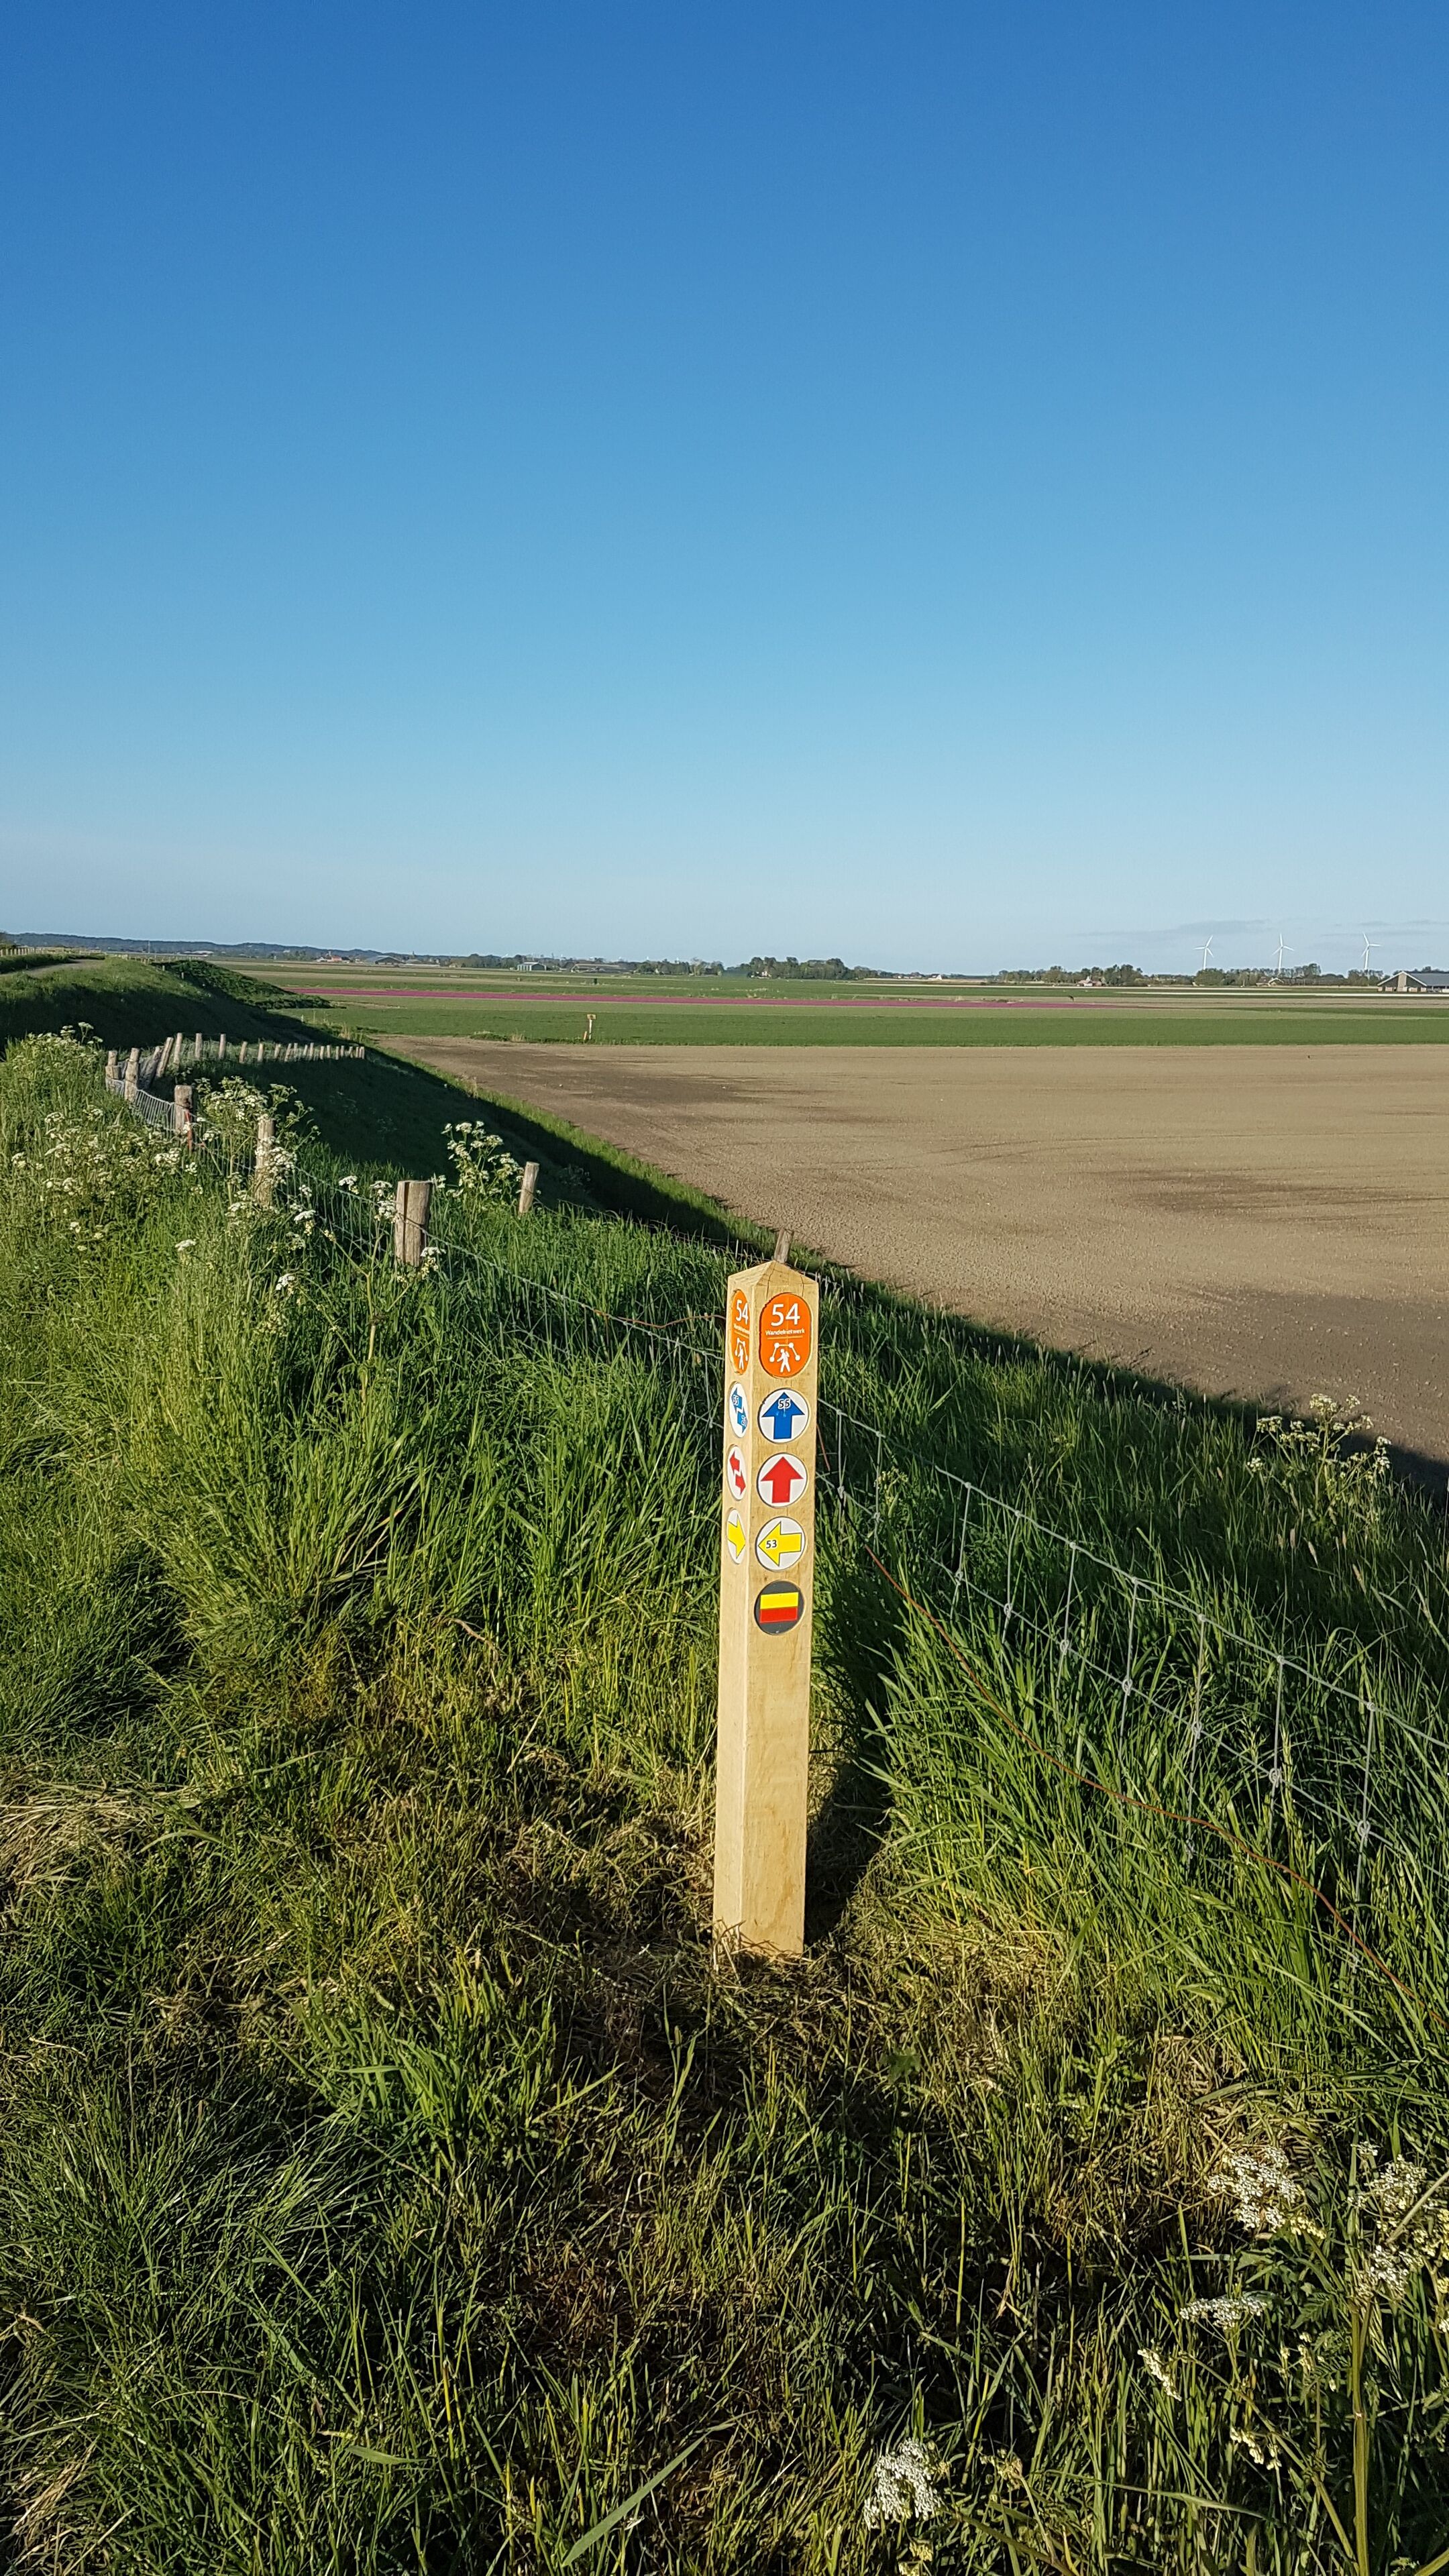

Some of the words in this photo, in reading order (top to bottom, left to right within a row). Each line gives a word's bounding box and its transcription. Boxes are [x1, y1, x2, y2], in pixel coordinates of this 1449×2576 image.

[736, 1299, 749, 1325] 54
[771, 1303, 800, 1326] 54
[765, 1328, 805, 1336] Wandelnetwerk
[778, 1398, 791, 1409] 55
[766, 1540, 777, 1548] 53
